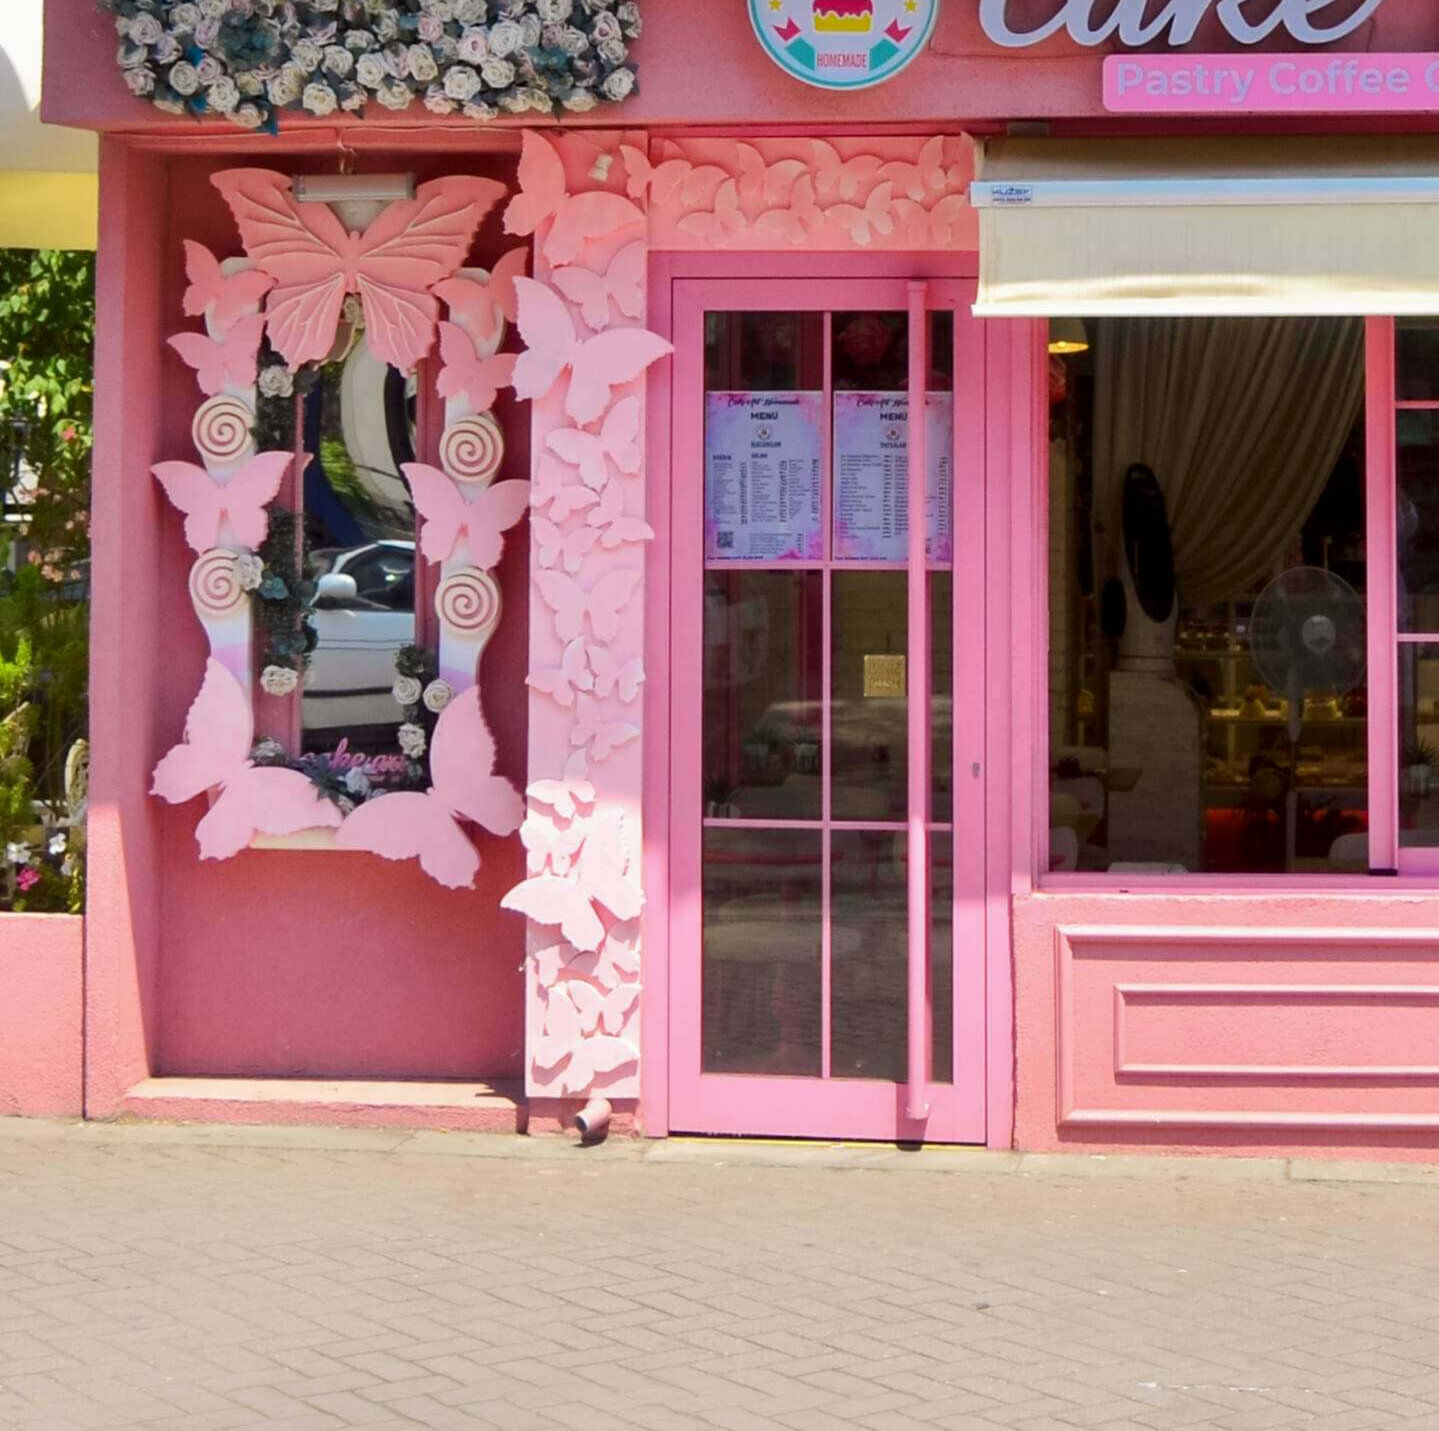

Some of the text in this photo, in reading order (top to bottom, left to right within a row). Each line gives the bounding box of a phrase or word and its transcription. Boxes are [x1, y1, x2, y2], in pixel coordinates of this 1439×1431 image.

[817, 53, 868, 68] HOMEMADE
[1117, 61, 1255, 104] Pastry
[1269, 59, 1411, 97] Coffee
